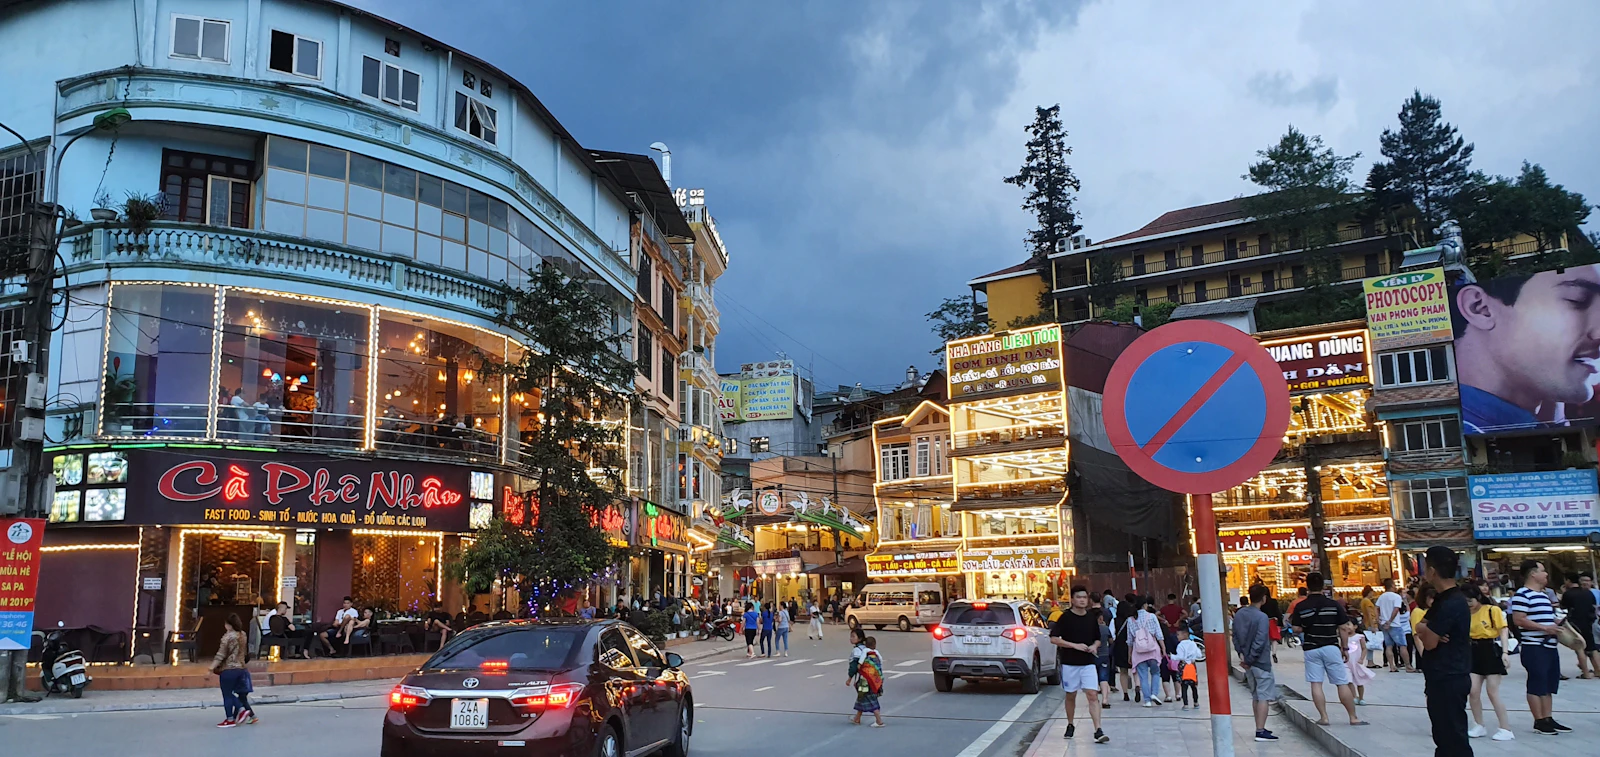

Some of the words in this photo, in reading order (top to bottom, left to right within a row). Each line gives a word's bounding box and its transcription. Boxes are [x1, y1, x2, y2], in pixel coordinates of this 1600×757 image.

[1367, 282, 1444, 310] PHOTOCOPY
[971, 340, 1002, 355] HÀNG
[1003, 332, 1031, 350] LIÊN
[1033, 327, 1059, 344] TÔN
[1265, 342, 1313, 362] UANG
[1318, 335, 1364, 357] DŨNG
[158, 460, 250, 502] Cà
[261, 462, 361, 506] Phê
[366, 471, 461, 510] Nhân
[1478, 502, 1530, 513] SAO
[205, 508, 226, 520] FAST
[229, 509, 250, 521] FOOD
[259, 510, 276, 521] SINH
[279, 507, 290, 522] TỐ
[297, 509, 318, 523] NƯỚC
[321, 512, 337, 524] HOA
[340, 510, 356, 524] QUẢ
[364, 510, 375, 525] ĐỒ
[377, 512, 395, 526] UỐNG
[398, 513, 410, 526] CÁC
[412, 516, 427, 528] LOẠI
[1236, 536, 1260, 550] LẨU
[16, 551, 32, 563] HỘI
[0, 564, 18, 576] MÙA
[20, 565, 30, 576] HÈ
[2, 582, 12, 591] SA
[14, 582, 24, 591] PA
[0, 598, 8, 606] M
[460, 702, 479, 713] 24A
[454, 714, 485, 726] 108.64
